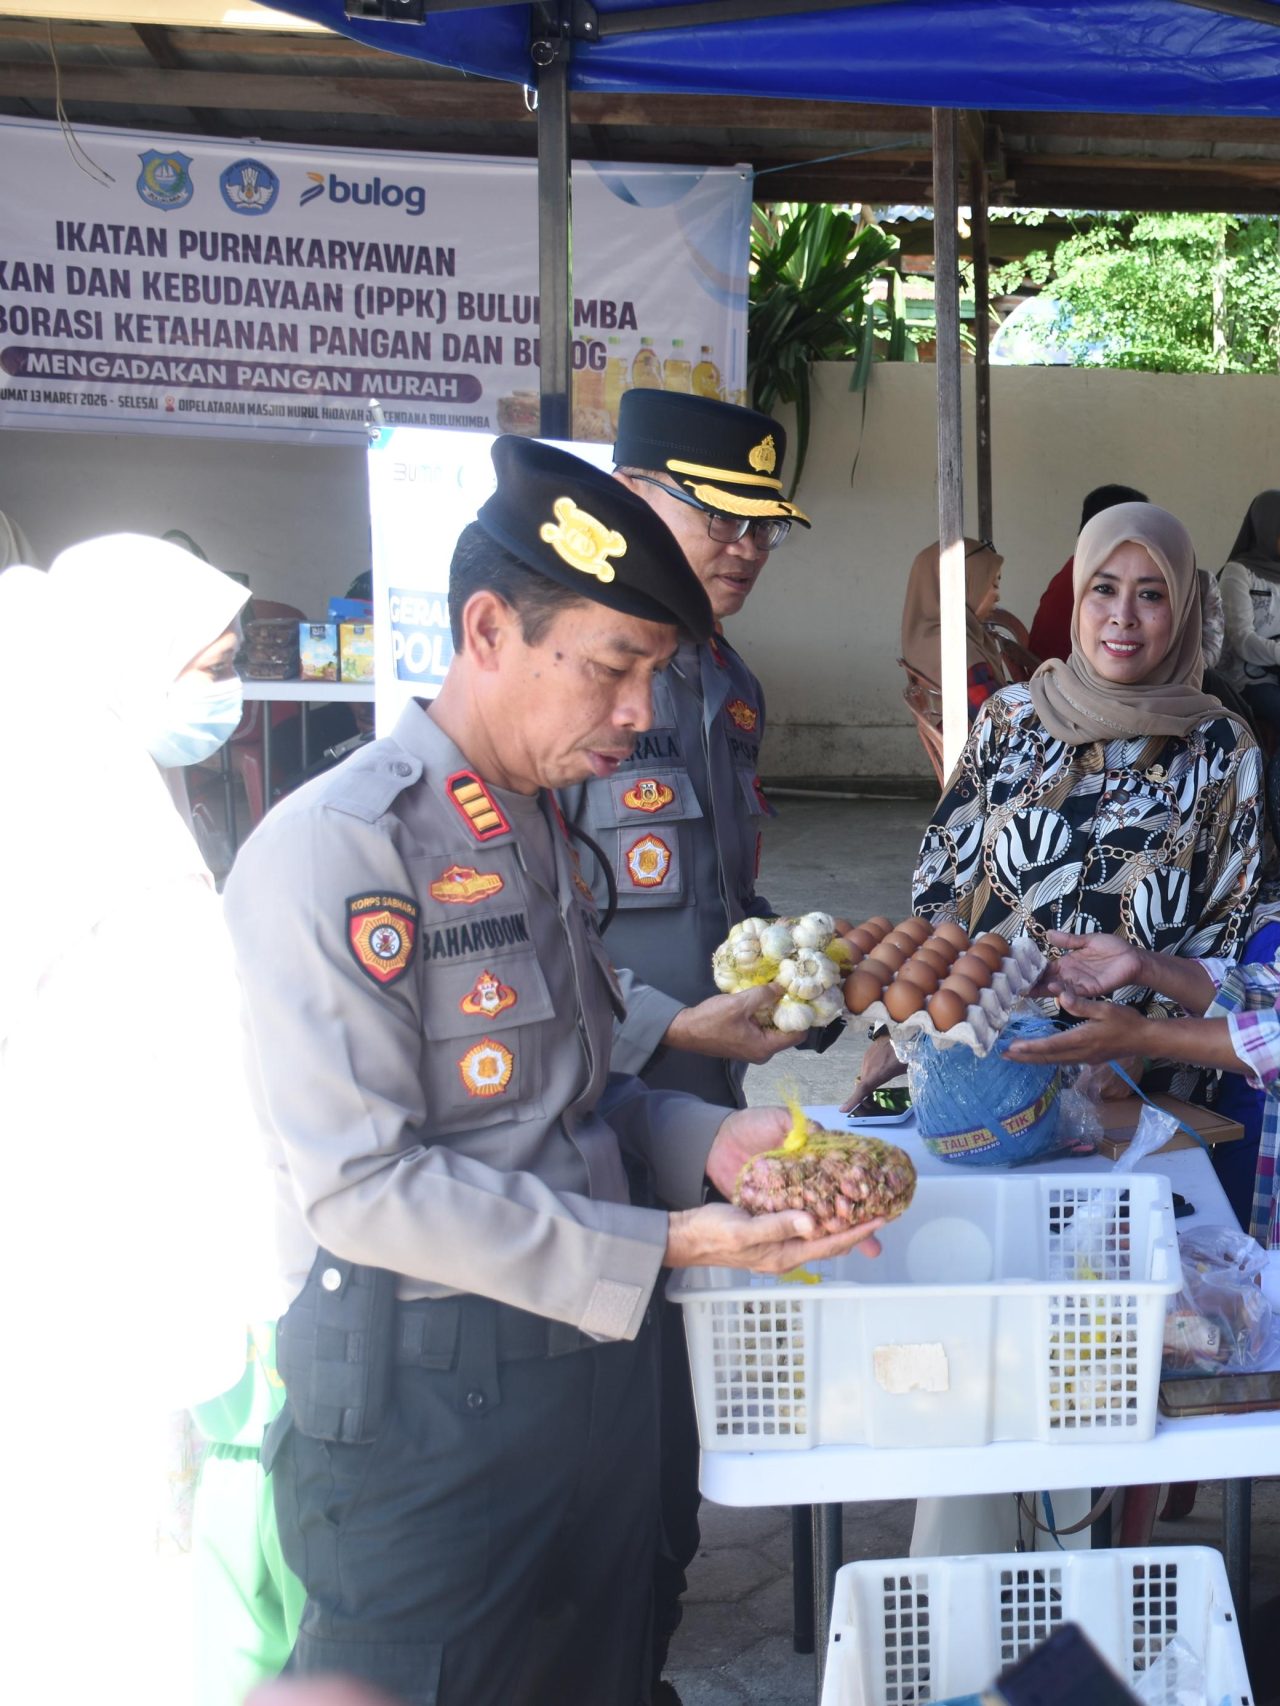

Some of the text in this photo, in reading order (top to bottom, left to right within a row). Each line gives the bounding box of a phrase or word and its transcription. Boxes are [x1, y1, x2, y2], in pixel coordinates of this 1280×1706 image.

[329, 174, 425, 216] bulog
[56, 220, 456, 277] IKATAN PURNAKARYAWAN
[66, 265, 131, 299] DAN
[142, 271, 344, 313] KEBUDAYAAN
[354, 283, 447, 324] (IPPK)
[457, 291, 638, 330] BULUMBA
[114, 312, 299, 353] KETAHANAN
[309, 325, 431, 361] PANGAN
[442, 333, 502, 366] DAN
[514, 337, 607, 371] BOG
[26, 353, 458, 398] MENGADAKAN PANGAN MURAH
[31, 390, 41, 403] 13
[44, 391, 78, 405] MARET
[81, 393, 107, 407] 2026
[118, 396, 159, 410] SELESAI
[178, 398, 246, 415] DIPELATARAN
[247, 402, 285, 417] MASJID
[287, 405, 320, 418] NURUL
[429, 414, 490, 428] BULUKUMBA
[390, 595, 450, 628] GERA
[351, 896, 381, 912] KORPS
[942, 1137, 968, 1150] TALI
